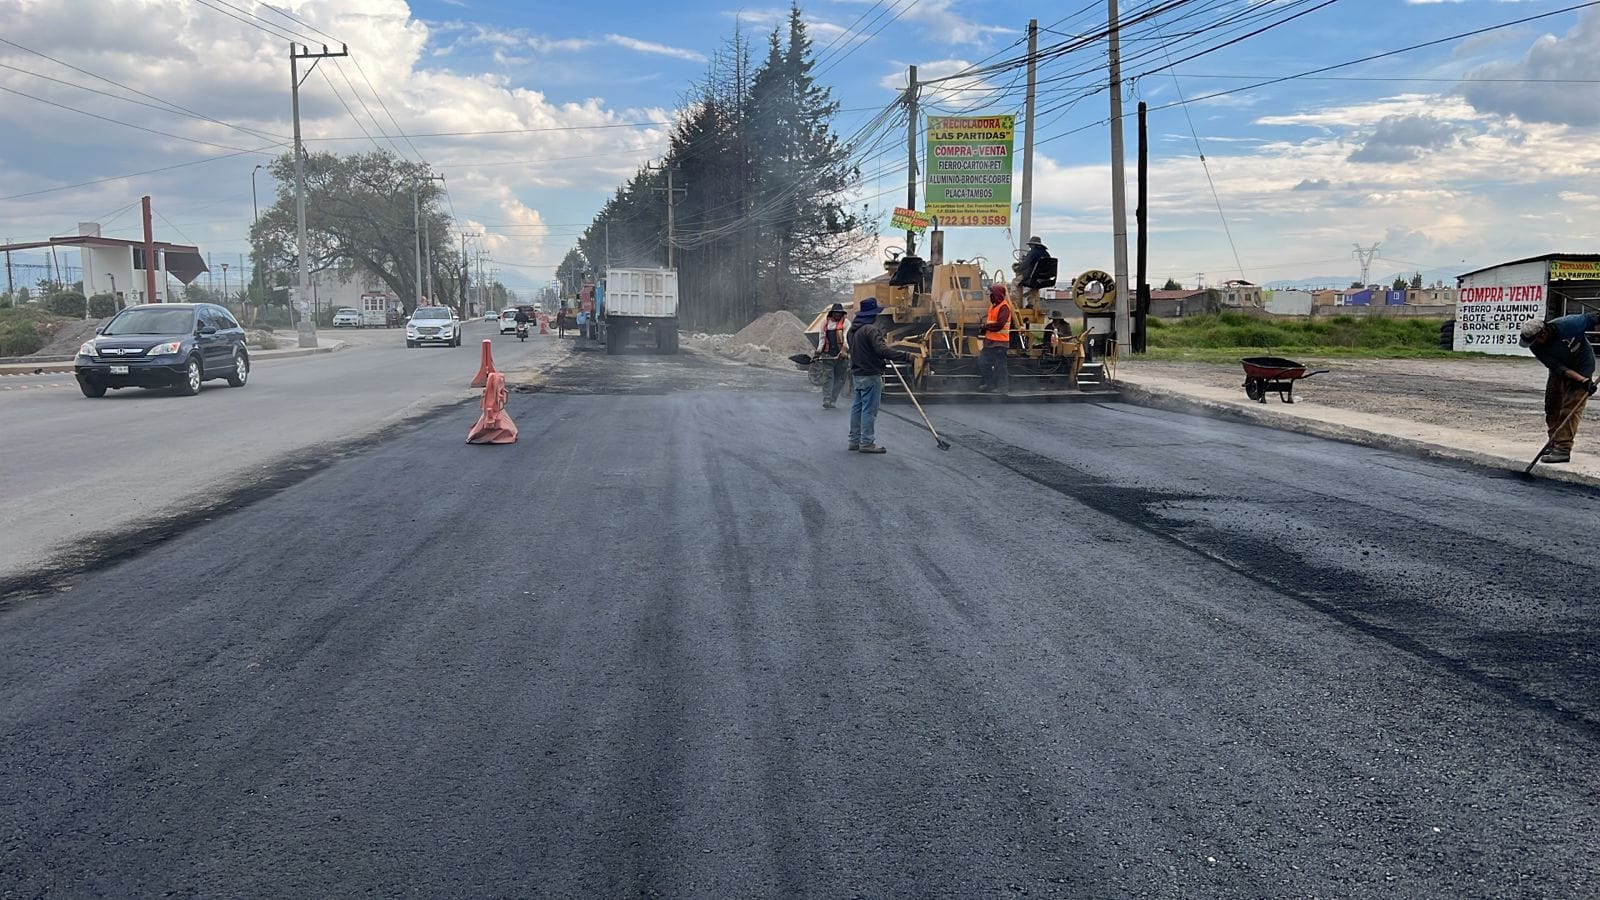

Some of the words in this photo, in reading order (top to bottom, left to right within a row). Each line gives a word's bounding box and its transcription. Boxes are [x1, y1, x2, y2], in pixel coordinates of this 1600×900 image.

[943, 118, 1001, 129] RECICLADORA
[934, 145, 972, 156] COMPRA
[979, 145, 1007, 156] VENTA
[939, 215, 958, 225] 722
[961, 215, 979, 225] 119
[982, 215, 1007, 225] 3589
[1463, 305, 1491, 313] FIERRO
[1496, 304, 1539, 313] ALUMINIO
[1463, 314, 1486, 322] BOTE
[1493, 313, 1535, 322] CARTON
[1462, 322, 1500, 331] BRONCE
[1475, 335, 1490, 344] 722
[1492, 334, 1505, 344] 119
